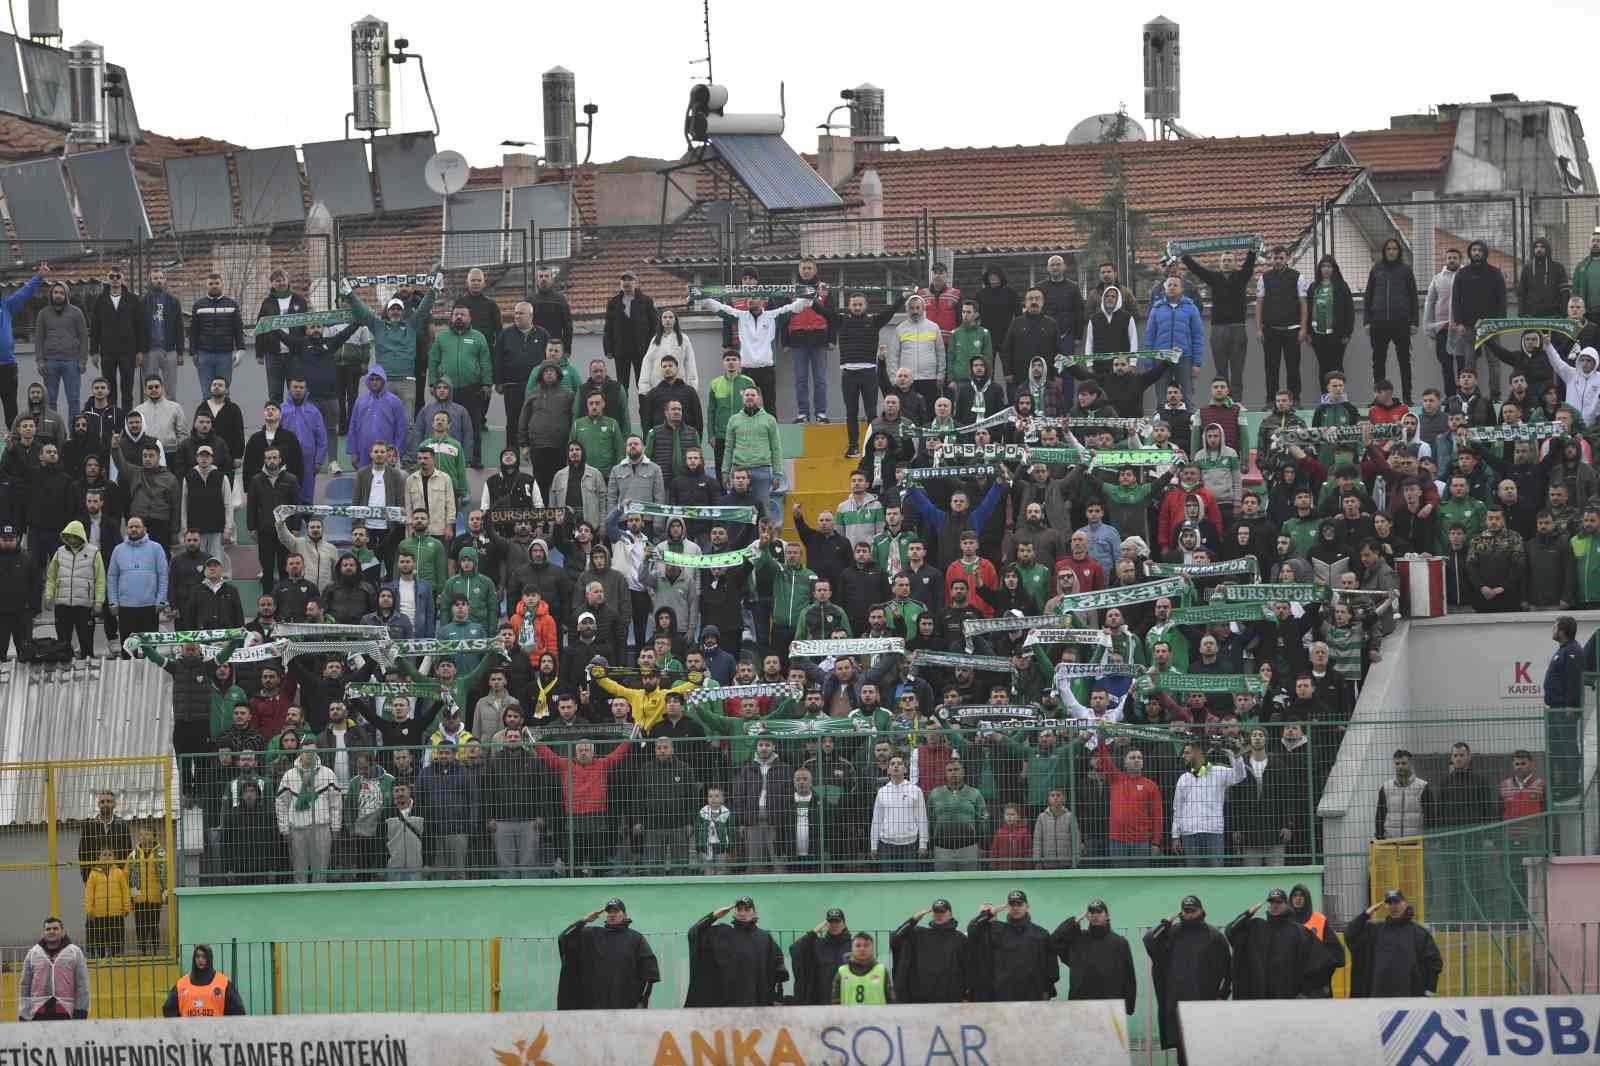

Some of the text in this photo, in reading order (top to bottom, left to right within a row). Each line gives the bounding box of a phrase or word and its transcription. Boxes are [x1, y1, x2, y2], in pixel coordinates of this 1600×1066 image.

[725, 284, 796, 293] BURSASPOR
[936, 444, 1024, 459] URSASPOR
[1227, 587, 1314, 601] BURSASPOR
[147, 629, 226, 642] TEXAS
[405, 638, 488, 652] TEXAS
[1515, 661, 1532, 684] K
[856, 985, 864, 1003] 8
[1480, 1007, 1600, 1055] ISB
[220, 1042, 295, 1066] TAMER
[651, 1028, 807, 1066] ANKA
[820, 1026, 989, 1066] SOLAR
